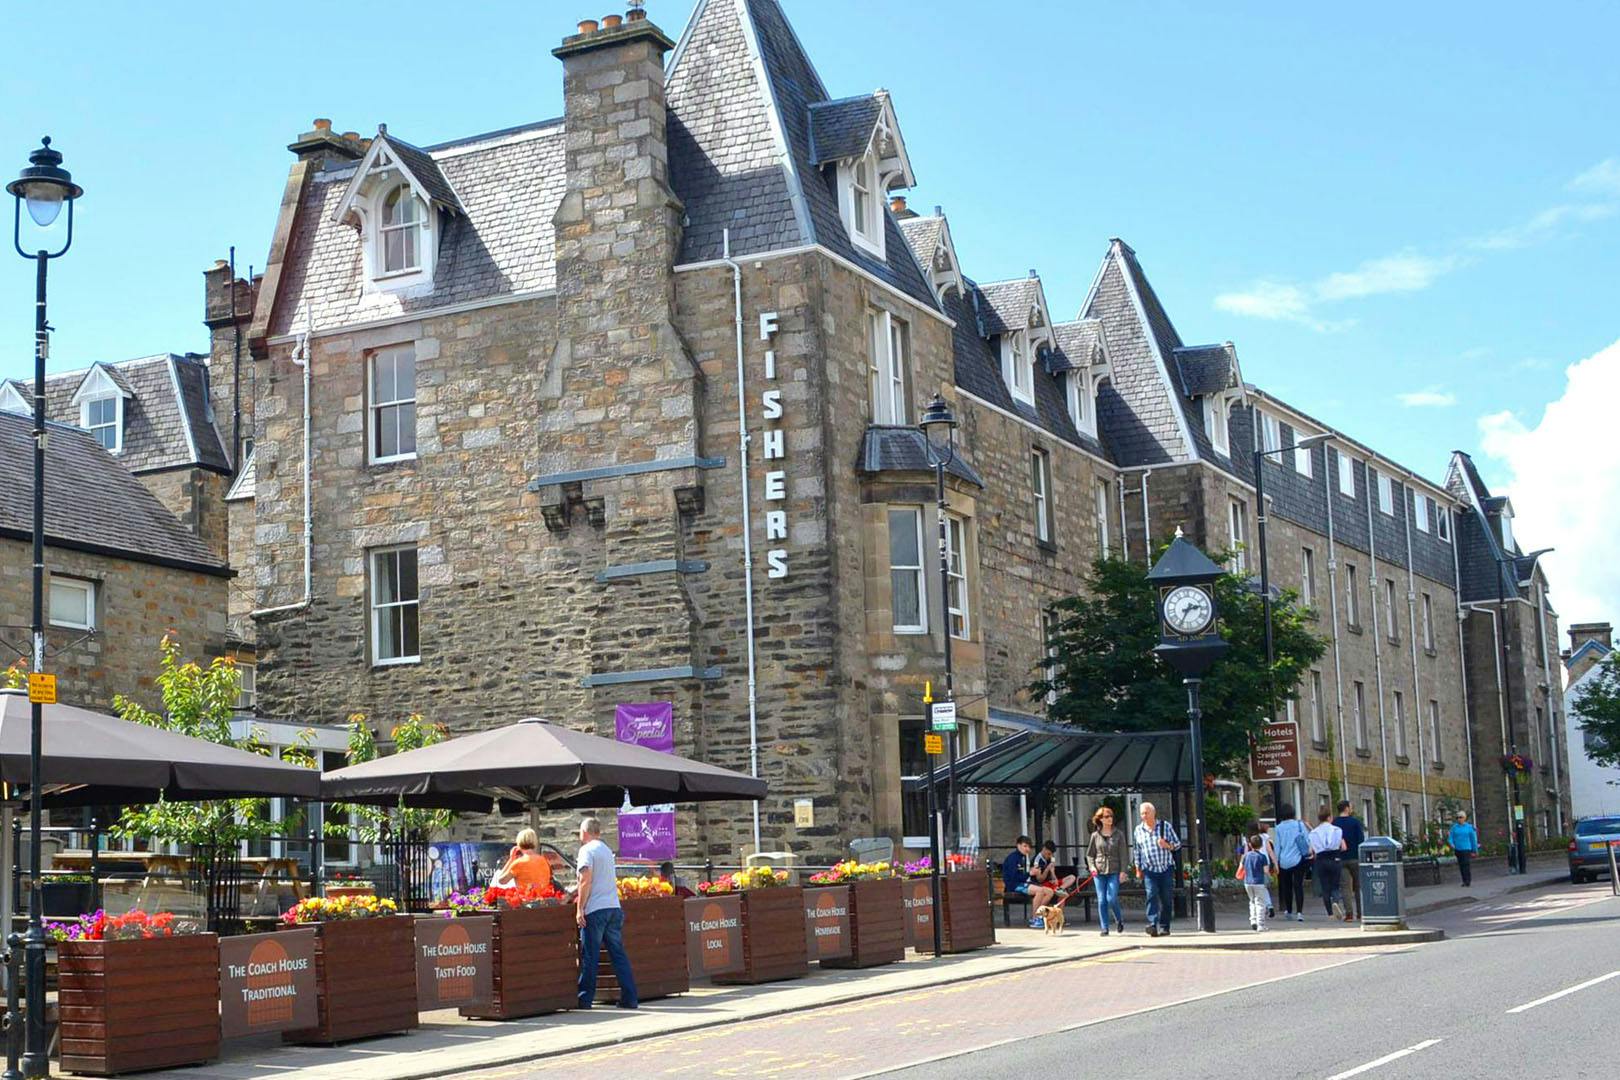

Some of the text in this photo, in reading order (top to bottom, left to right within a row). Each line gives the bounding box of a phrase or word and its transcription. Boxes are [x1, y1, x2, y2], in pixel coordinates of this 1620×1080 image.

[759, 311, 788, 579] FISHERS
[620, 722, 667, 744] Special
[1264, 728, 1294, 737] Hotels
[816, 907, 831, 918] COACH
[831, 907, 846, 916] HOUSE
[689, 918, 737, 932] THE COACH HOUSE
[422, 942, 487, 957] THE COACH HOUSE
[706, 939, 723, 950] LOCAL
[228, 958, 308, 978] THE COACH HOUSE
[434, 965, 476, 979] TASTY FOOD
[241, 984, 297, 1002] TRADITIONAL
